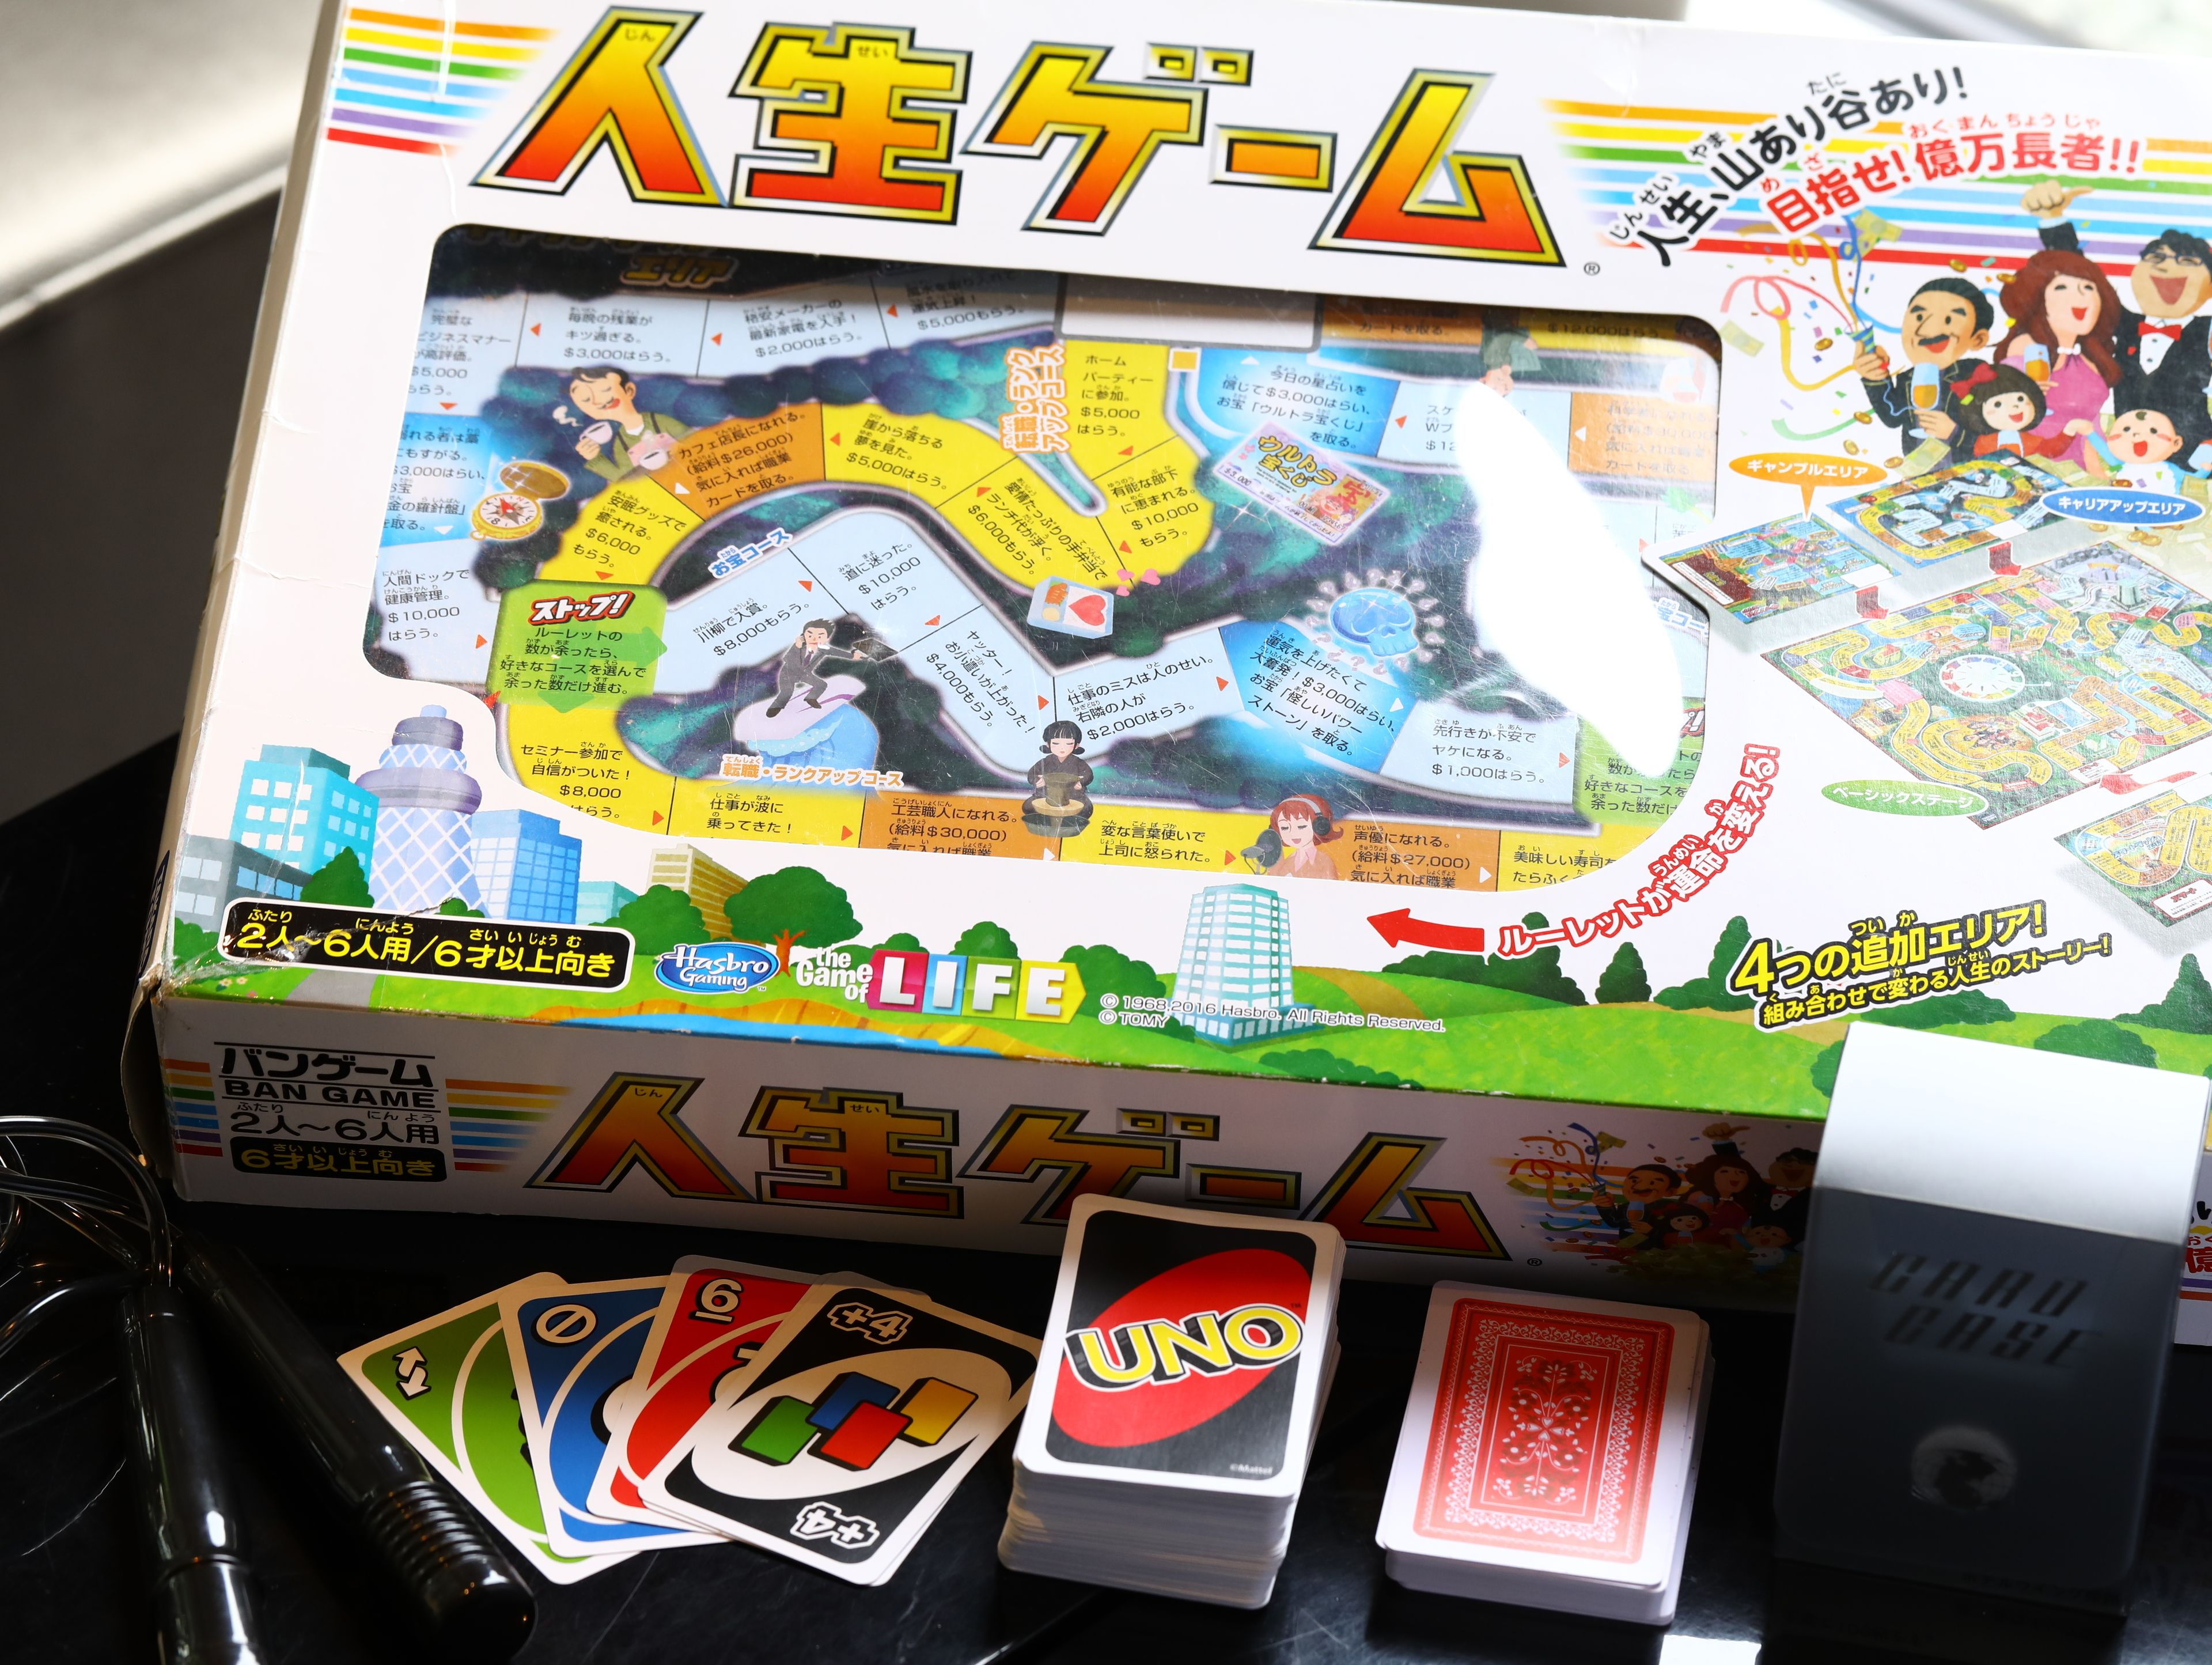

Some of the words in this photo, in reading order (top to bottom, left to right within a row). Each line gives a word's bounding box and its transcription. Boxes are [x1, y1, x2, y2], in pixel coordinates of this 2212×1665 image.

[1808, 72, 1846, 94] たに
[468, 5, 1566, 268] 人生ゲーム
[1690, 131, 1727, 160] やま
[1085, 355, 1126, 366] ホーム
[1271, 369, 1367, 395] 今日の星占いを
[1082, 390, 1129, 402] に参加。
[1081, 407, 1140, 419] $5,000
[679, 411, 805, 459] カフェ店長になれる。
[863, 418, 944, 449] 崖から落ちる
[1077, 424, 1126, 437] はらう。
[854, 434, 913, 461] 夢を見た。
[1259, 436, 1338, 485] ウルトラ
[696, 452, 792, 493] 気に入れば職業
[846, 451, 948, 491] $5,000はらう。
[1259, 454, 1310, 487] 宝くじ
[1747, 460, 1869, 479] ギャンブルエリア
[706, 475, 794, 508] カードを取る。
[1111, 468, 1179, 498] 有能な部下
[607, 494, 688, 532] 安眠グッズで
[1121, 486, 1196, 514] に恵まれる。
[2058, 496, 2186, 517] キャリアアップエリア
[594, 510, 652, 541] 癒される。
[1131, 502, 1199, 531] $10,000
[585, 527, 641, 555] $6,000
[968, 505, 1035, 576] $6,000もらう。
[1139, 529, 1187, 548] もらう。
[573, 543, 615, 568] もらう。
[711, 529, 790, 577] お宝コース
[843, 543, 912, 581] 道に迷った。
[383, 569, 469, 588] 人間ドックで
[858, 557, 921, 595] $10,000
[385, 590, 449, 605] 健康管理。
[870, 585, 916, 611] はらう。
[388, 607, 460, 623] $10,000
[698, 603, 768, 644] 川柳で入賞。
[388, 629, 438, 641] はらう。
[535, 627, 623, 642] ルーレットの
[713, 603, 810, 657] $8,000もらう。
[525, 643, 618, 659] 数が余ったら、
[1266, 634, 1368, 693] 運気を上げたくて
[500, 659, 646, 678] 好きなコースを選んで
[1067, 656, 1214, 707] 仕事のミスは人のせい。
[504, 676, 628, 695] 余った数だけ進む。
[926, 653, 993, 728] $4,000もらう。
[1075, 695, 1147, 723] 右隣の人が
[1088, 703, 1195, 740] $2,000はらう。
[1433, 725, 1536, 743] 先行きが不安で
[521, 744, 623, 761] セミナー参加で
[1432, 744, 1513, 762] ヤケになる。
[1432, 764, 1545, 784] $1,000はらう。
[559, 785, 622, 799] $8,000
[1833, 788, 1974, 808] ベーシックステージ
[710, 799, 783, 814] 仕事が波に
[892, 804, 1018, 823] 工芸職人になれる。
[1101, 824, 1206, 843] 変な言葉使いで
[1354, 830, 1450, 848] 声優になれる。
[1099, 843, 1210, 864] 上司に怒られた。
[1351, 870, 1456, 888] 気に入れば職業
[248, 910, 293, 922] ふたり
[666, 945, 768, 975] Hasbro
[816, 948, 851, 967] the
[680, 967, 747, 989] Gaming
[796, 961, 873, 987] Game
[880, 956, 1065, 1016] LIFE
[844, 982, 868, 1002] of
[1120, 1013, 1169, 1029] TOMY
[1222, 1005, 1281, 1020] Hasbro.
[1287, 1008, 1308, 1022] All
[1312, 1011, 1363, 1028] Rights
[1368, 1015, 1445, 1032] Reserved.
[222, 1047, 434, 1087] バンゲーム
[225, 1079, 305, 1102] BAN
[323, 1084, 435, 1109] GAME
[241, 1149, 435, 1176] 6才以上向き
[522, 1072, 1513, 1263] 人生ゲーム
[1869, 1252, 2088, 1318] CARD
[827, 1301, 912, 1345] +4
[1066, 1304, 1304, 1391] UNO
